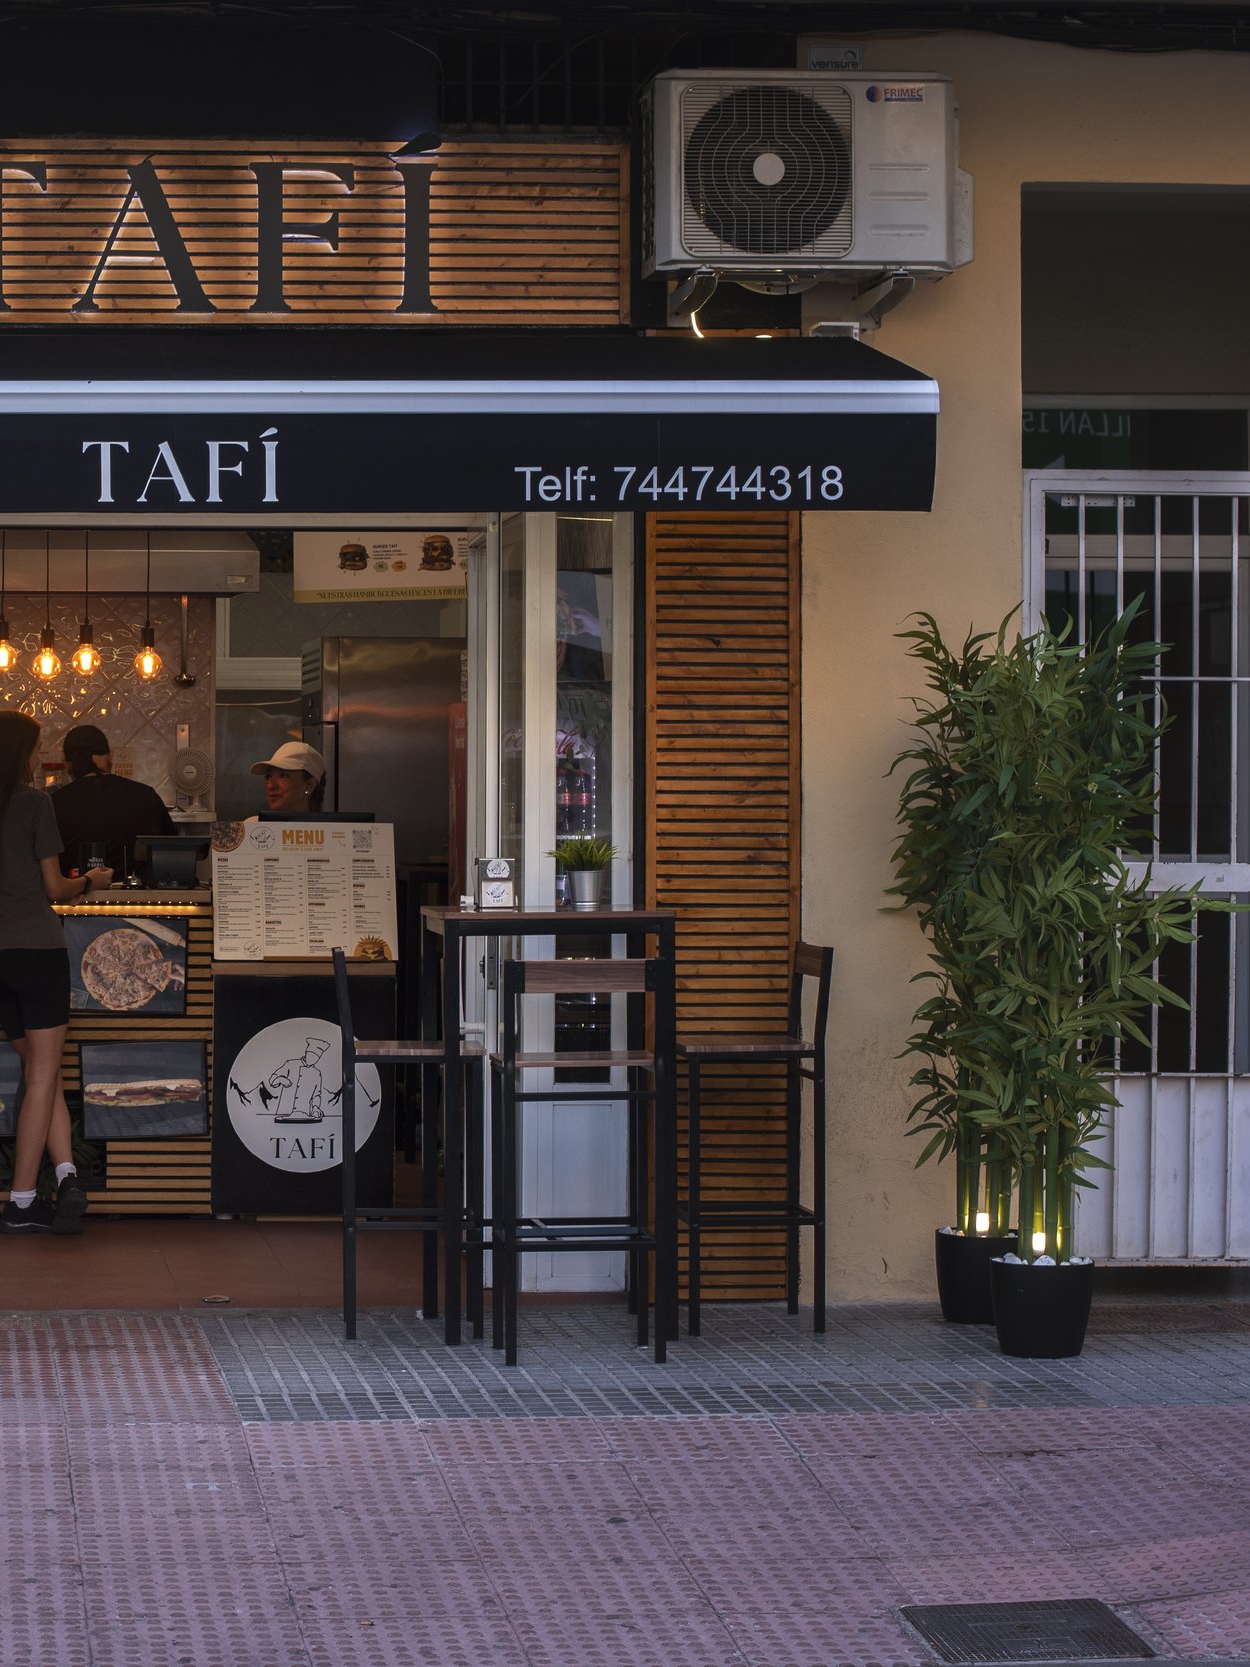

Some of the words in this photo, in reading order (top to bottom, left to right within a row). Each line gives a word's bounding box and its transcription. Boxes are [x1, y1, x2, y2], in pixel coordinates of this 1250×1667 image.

[812, 60, 858, 69] verisure
[884, 88, 923, 97] FRIMEC
[82, 427, 279, 502] TAFÍ
[514, 466, 595, 501] Telf:
[614, 465, 843, 501] 744744318
[282, 830, 324, 844] MENU
[270, 1134, 334, 1159] TAFÍ
